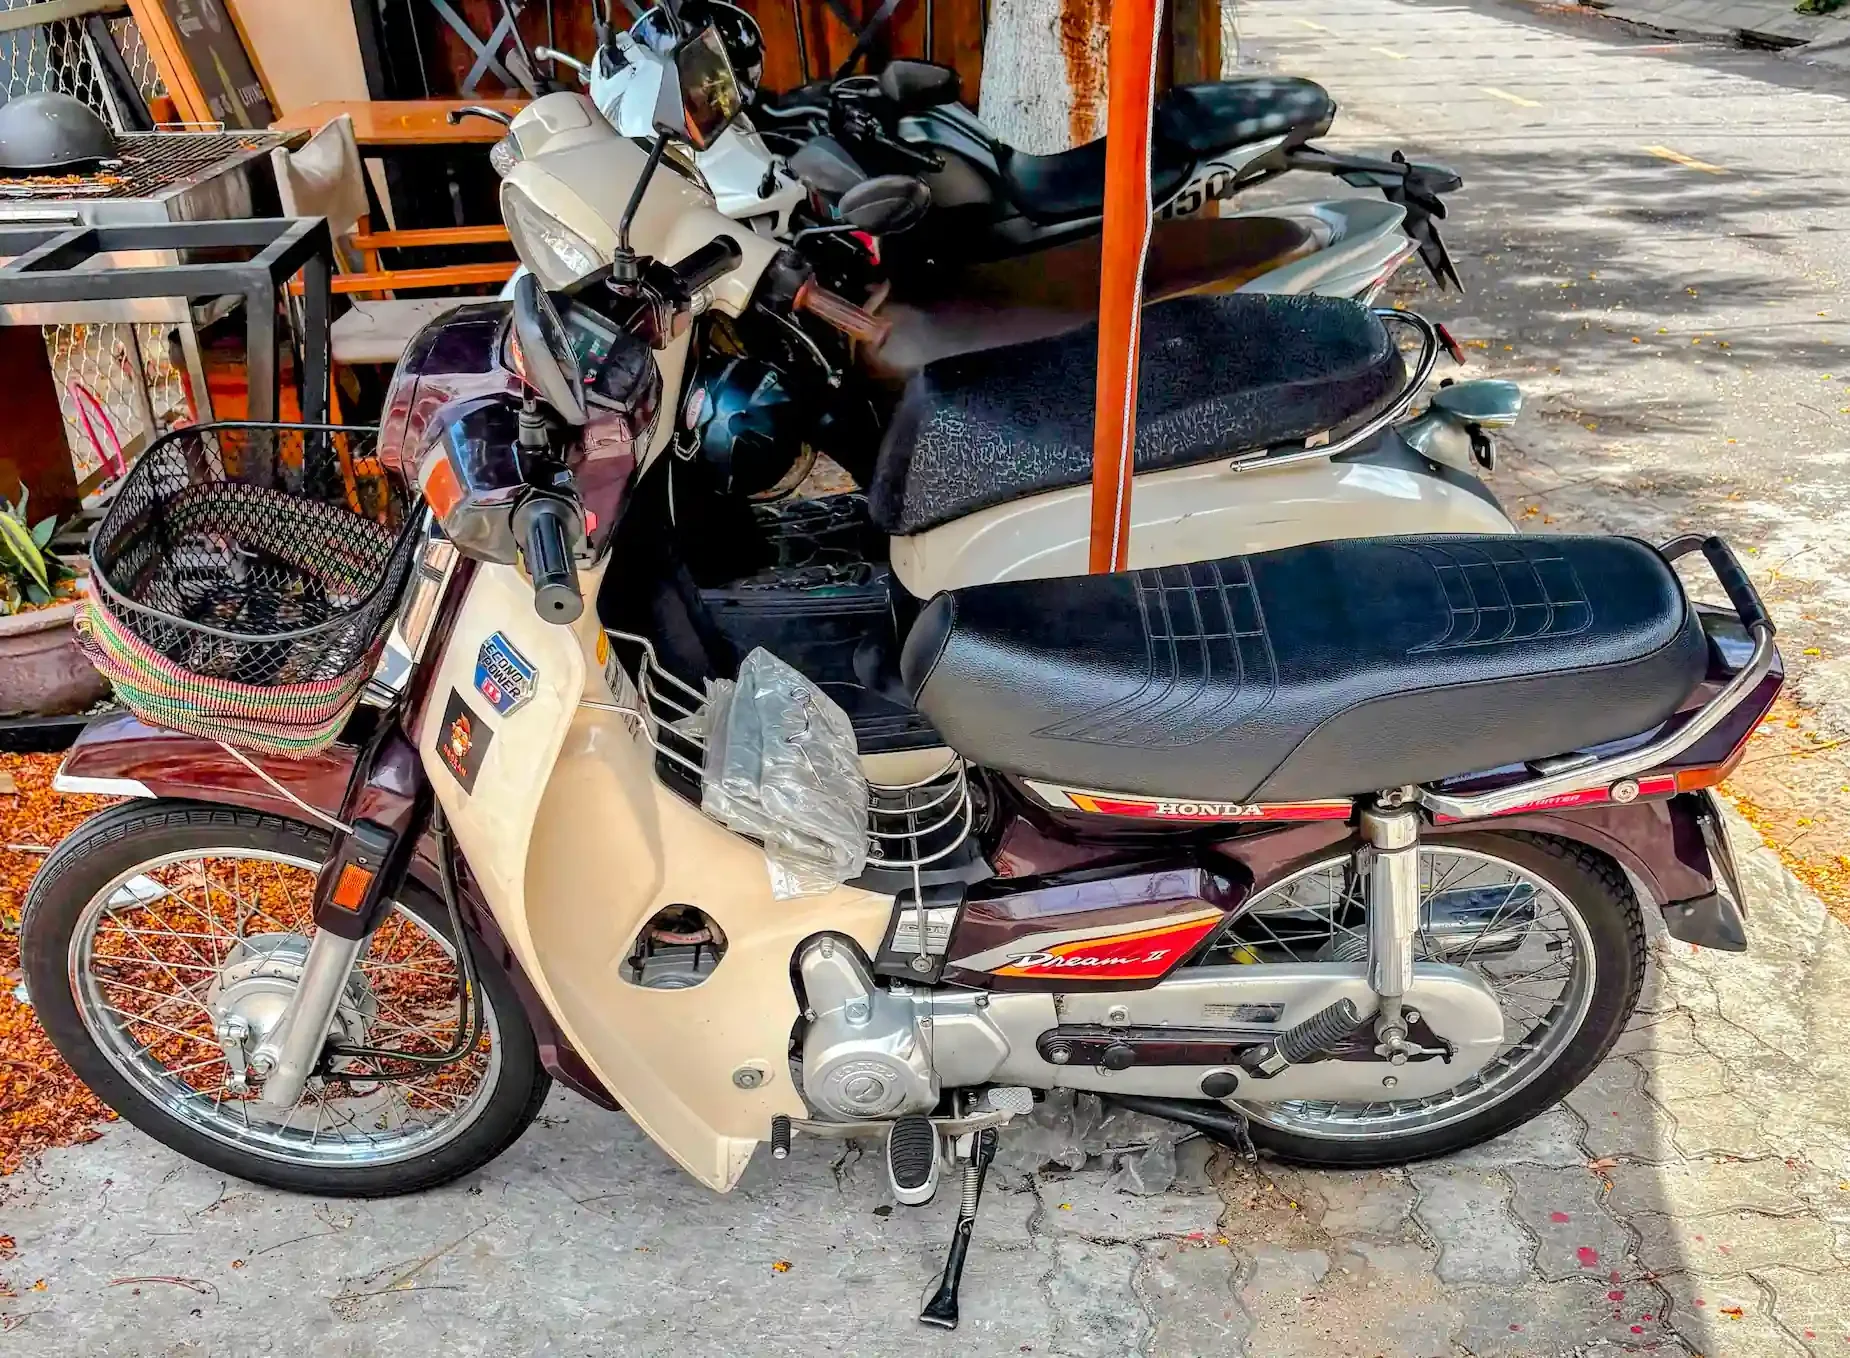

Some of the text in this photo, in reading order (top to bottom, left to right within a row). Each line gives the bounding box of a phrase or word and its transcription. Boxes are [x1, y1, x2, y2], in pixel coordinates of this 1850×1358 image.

[482, 655, 521, 698] POWER
[486, 643, 523, 682] ECONO
[1155, 803, 1265, 816] HONDA
[1006, 949, 1171, 968] Dream II
